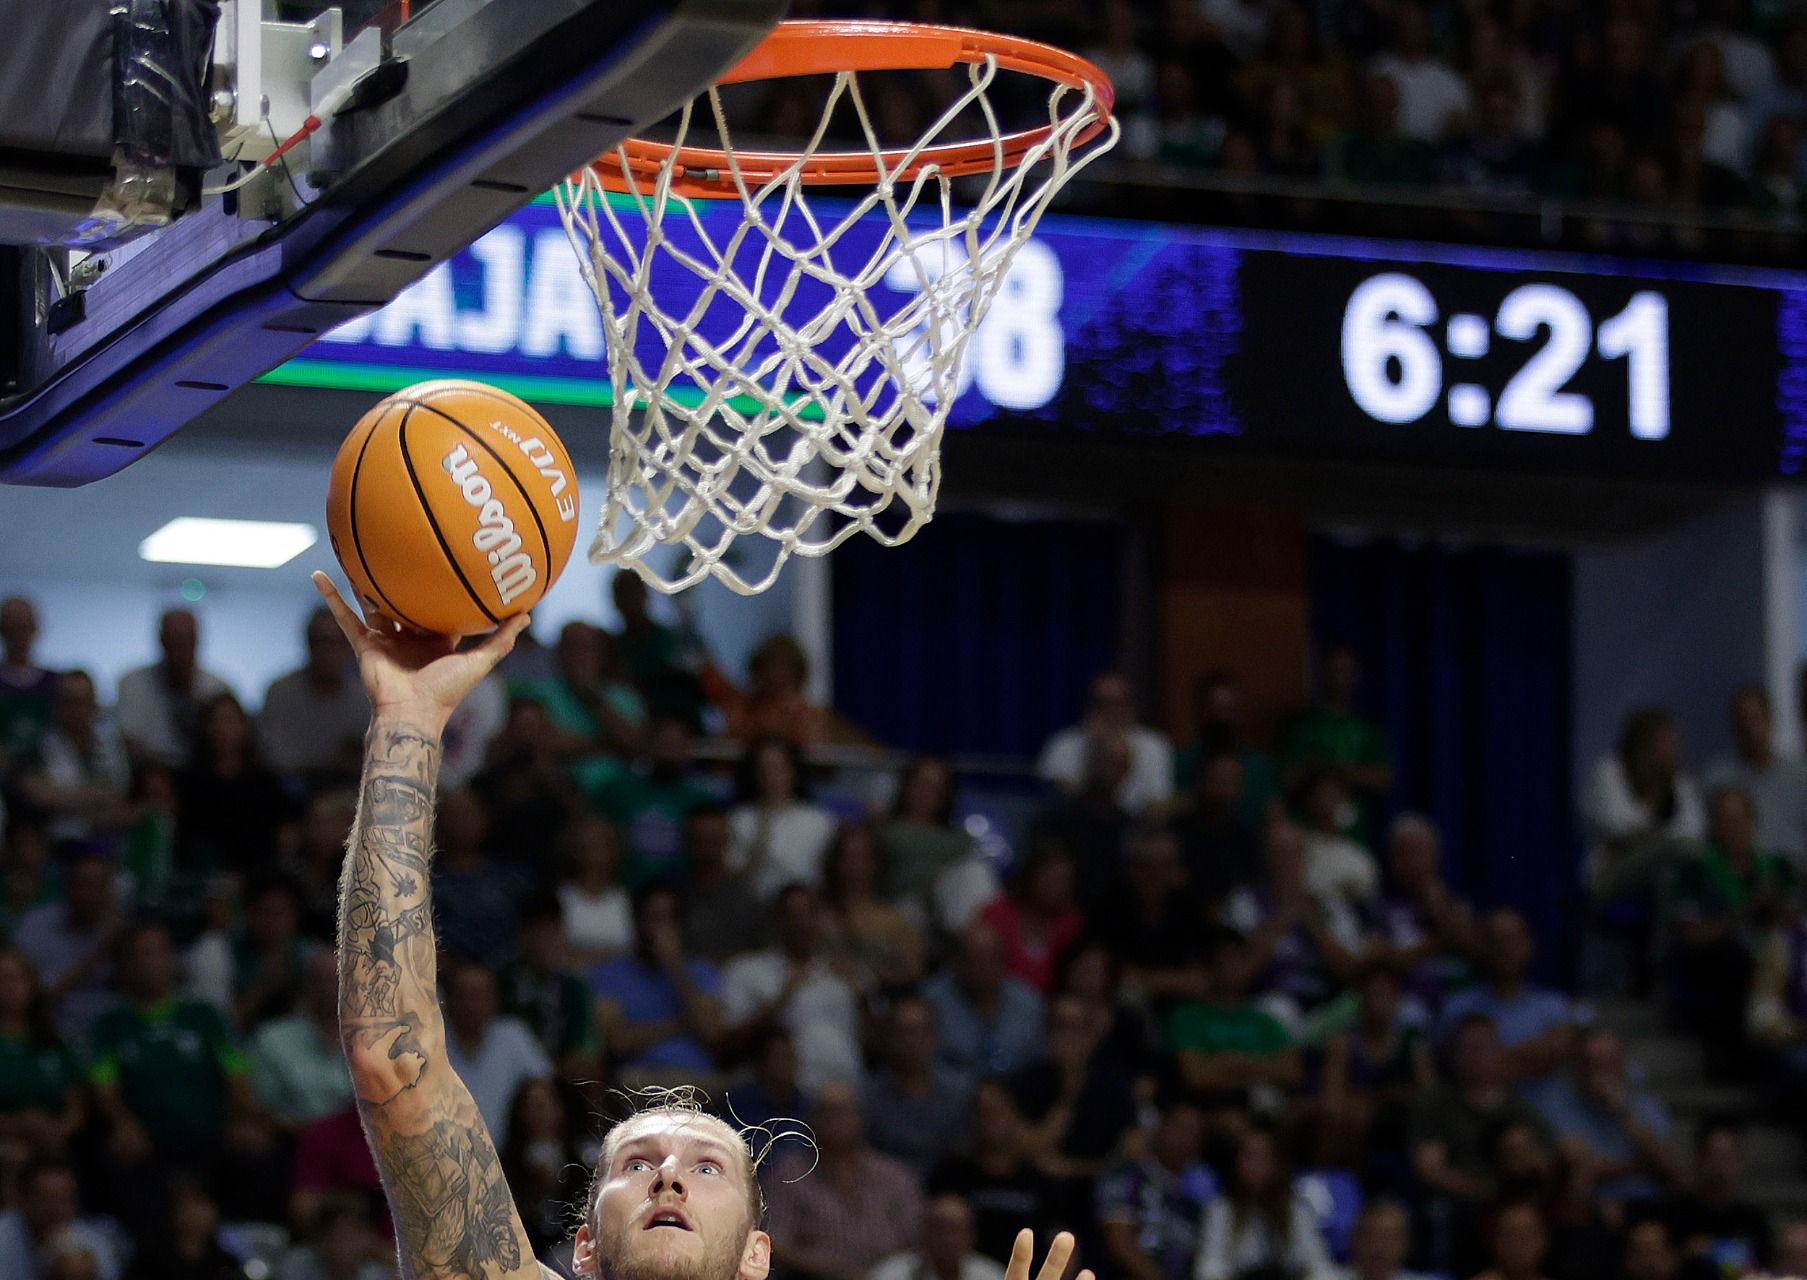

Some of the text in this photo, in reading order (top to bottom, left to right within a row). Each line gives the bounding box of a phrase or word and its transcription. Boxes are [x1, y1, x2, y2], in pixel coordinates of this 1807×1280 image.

[321, 224, 607, 361] AJA
[1341, 272, 1671, 440] 6:21
[442, 443, 538, 606] Wilson
